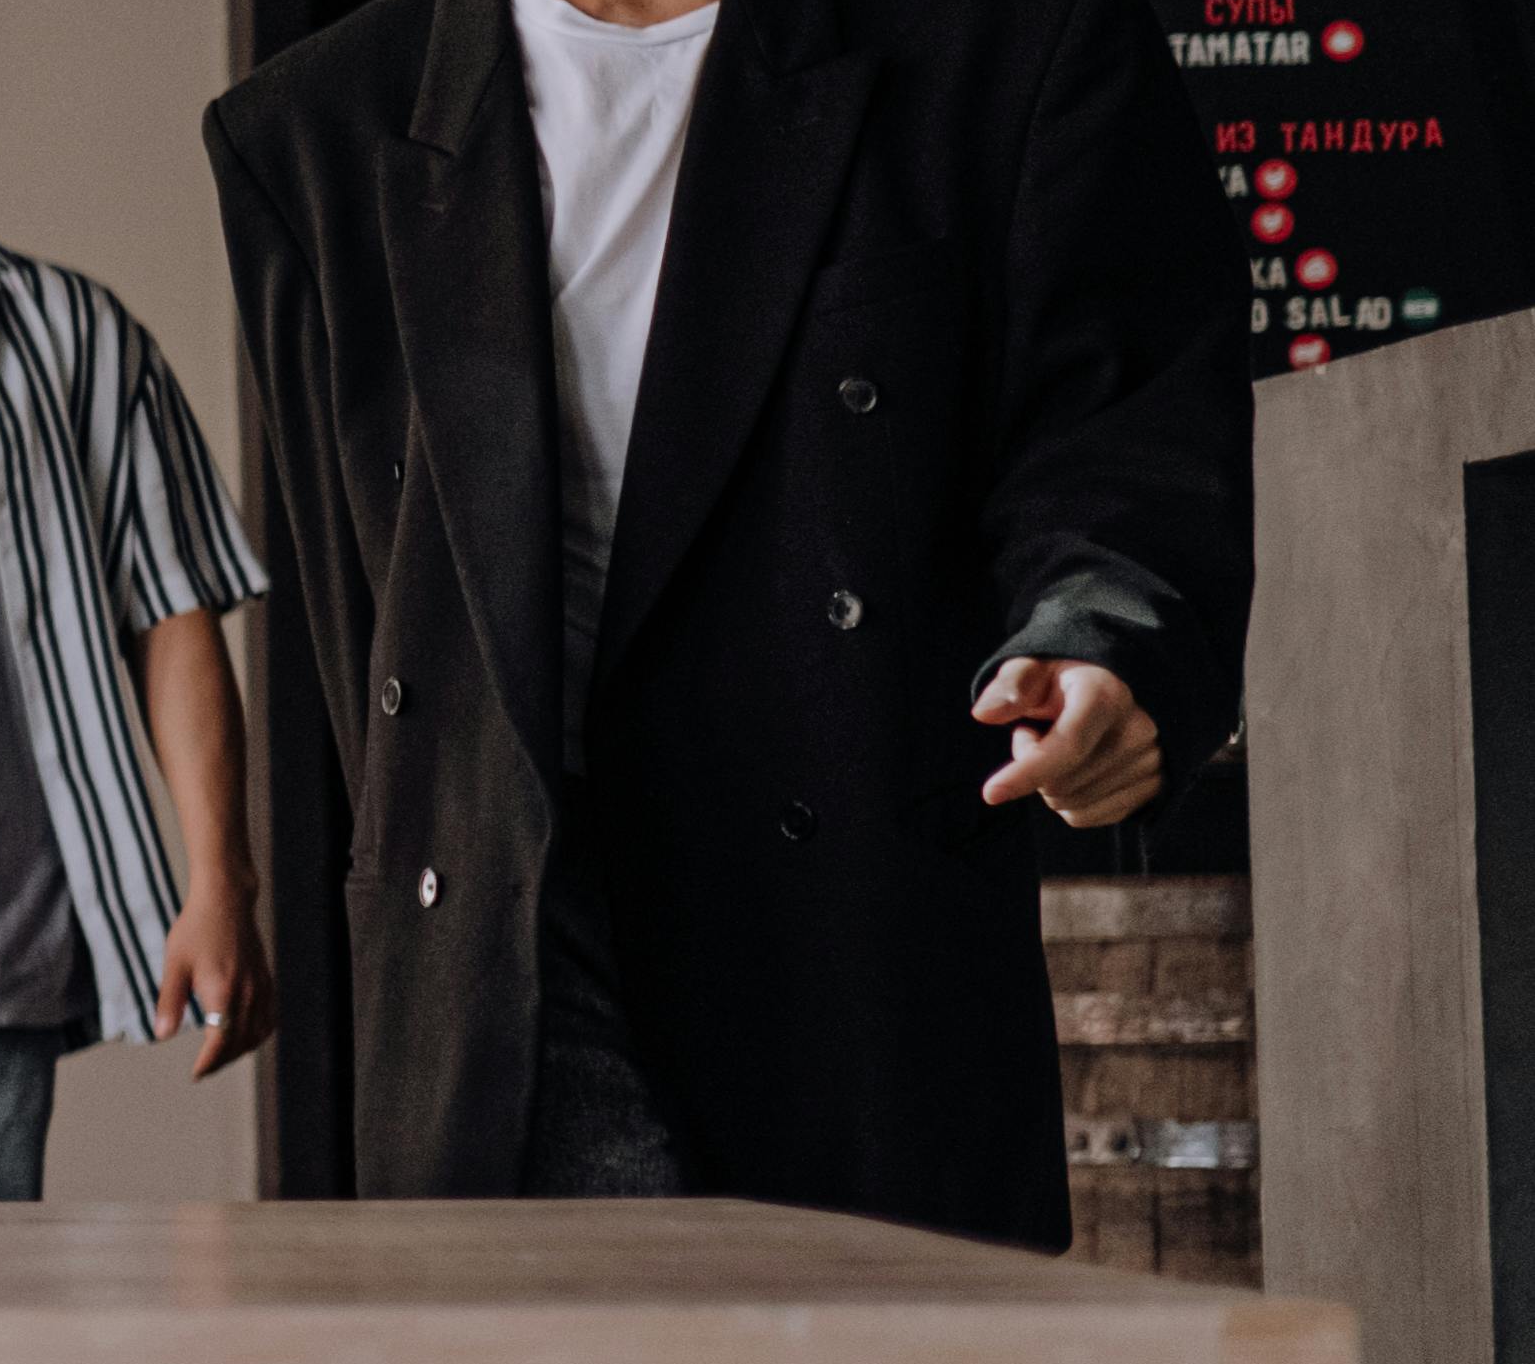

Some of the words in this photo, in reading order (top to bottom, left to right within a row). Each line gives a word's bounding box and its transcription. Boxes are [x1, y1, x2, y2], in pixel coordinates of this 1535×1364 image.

[1216, 121, 1255, 152] ИЗ
[1281, 118, 1443, 152] ТАНДУРА
[1287, 296, 1392, 330] SALAD
